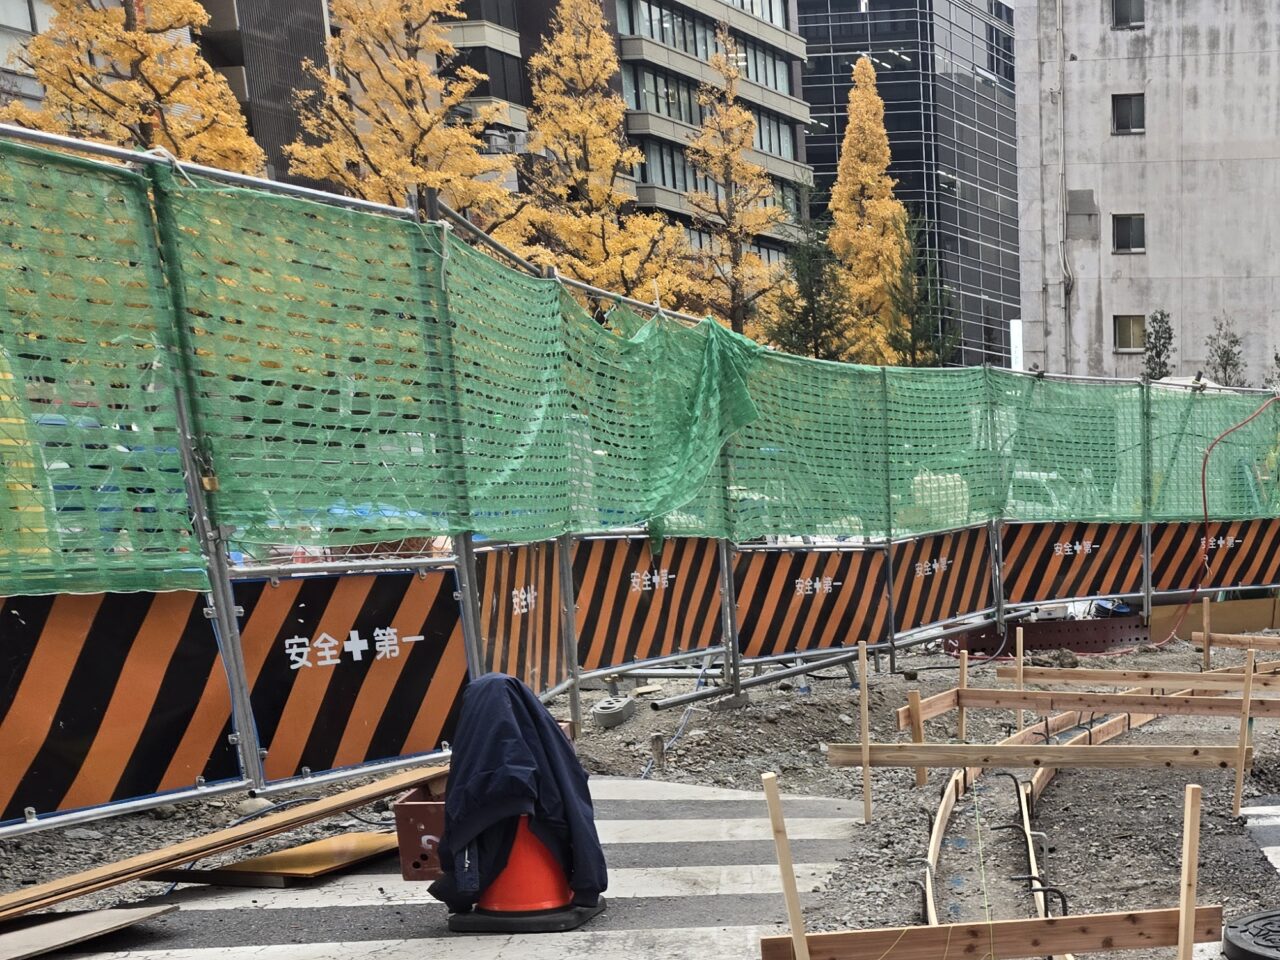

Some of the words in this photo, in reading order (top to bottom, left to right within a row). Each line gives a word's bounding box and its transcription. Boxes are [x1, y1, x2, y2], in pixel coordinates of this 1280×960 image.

[1053, 541, 1100, 556] 安全第一
[630, 569, 676, 592] 安全第一
[795, 576, 842, 595] 安全第一
[285, 626, 424, 669] 安全第一
